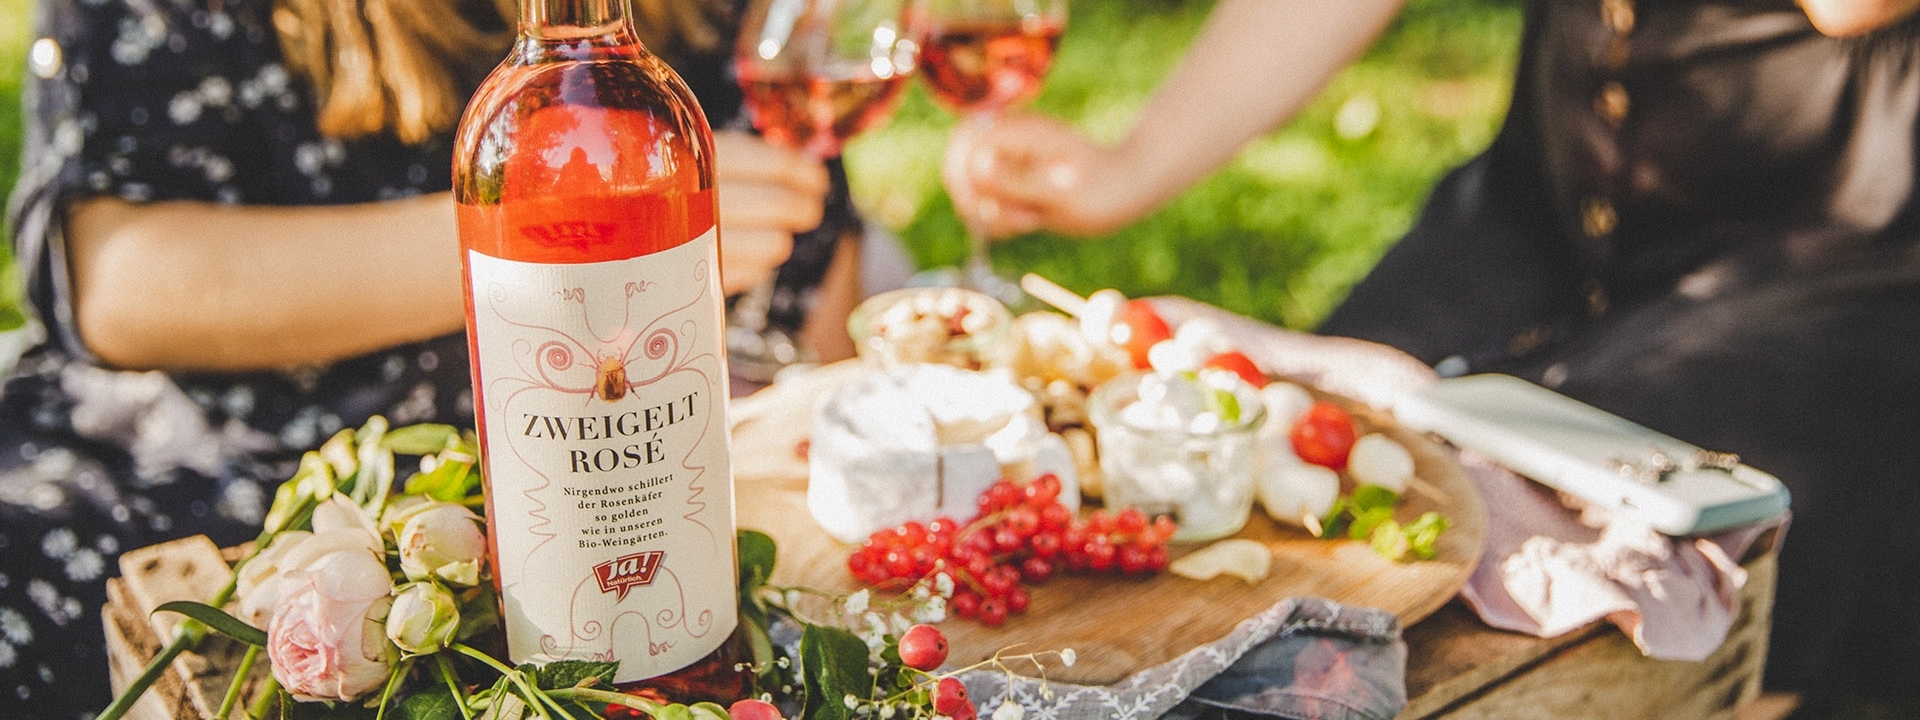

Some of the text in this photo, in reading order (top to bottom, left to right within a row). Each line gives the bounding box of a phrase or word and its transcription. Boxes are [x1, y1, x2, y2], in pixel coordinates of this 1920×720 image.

[523, 391, 699, 441] ZWEIGELT
[568, 432, 666, 474] ROSÉ
[563, 473, 674, 498] Nirgendwo schillert
[577, 490, 664, 510] der Rosenkäfer
[594, 507, 650, 523] so golden
[581, 517, 664, 536] wie in unseren
[578, 530, 669, 549] Bio-Weingärten.
